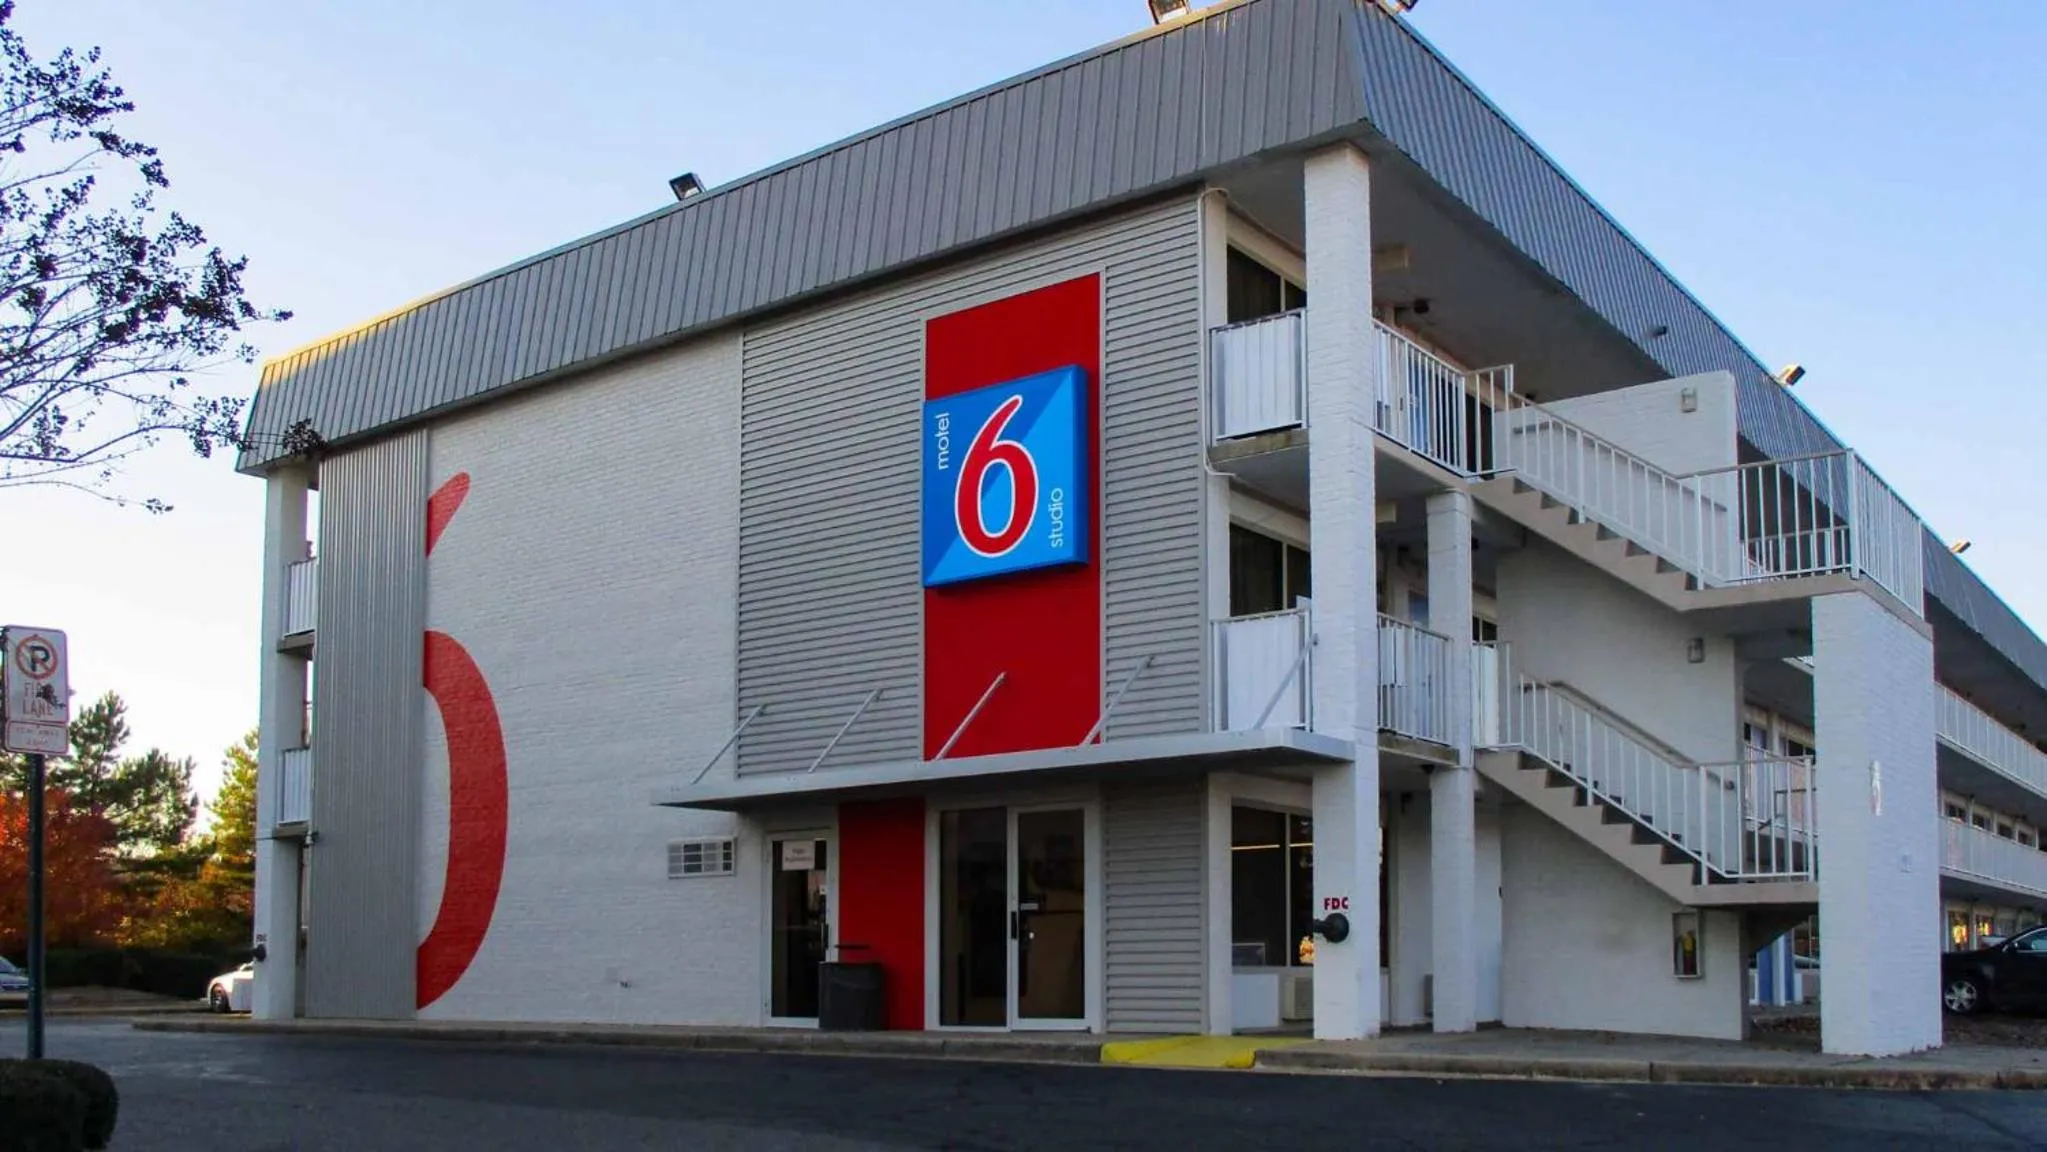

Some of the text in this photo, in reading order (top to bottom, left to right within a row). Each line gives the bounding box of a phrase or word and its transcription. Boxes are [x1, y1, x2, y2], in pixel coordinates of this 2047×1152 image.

[934, 412, 950, 470] motel
[954, 394, 1040, 558] 6
[1047, 487, 1064, 549] studio
[22, 698, 54, 716] LANE
[1323, 896, 1349, 911] FDC
